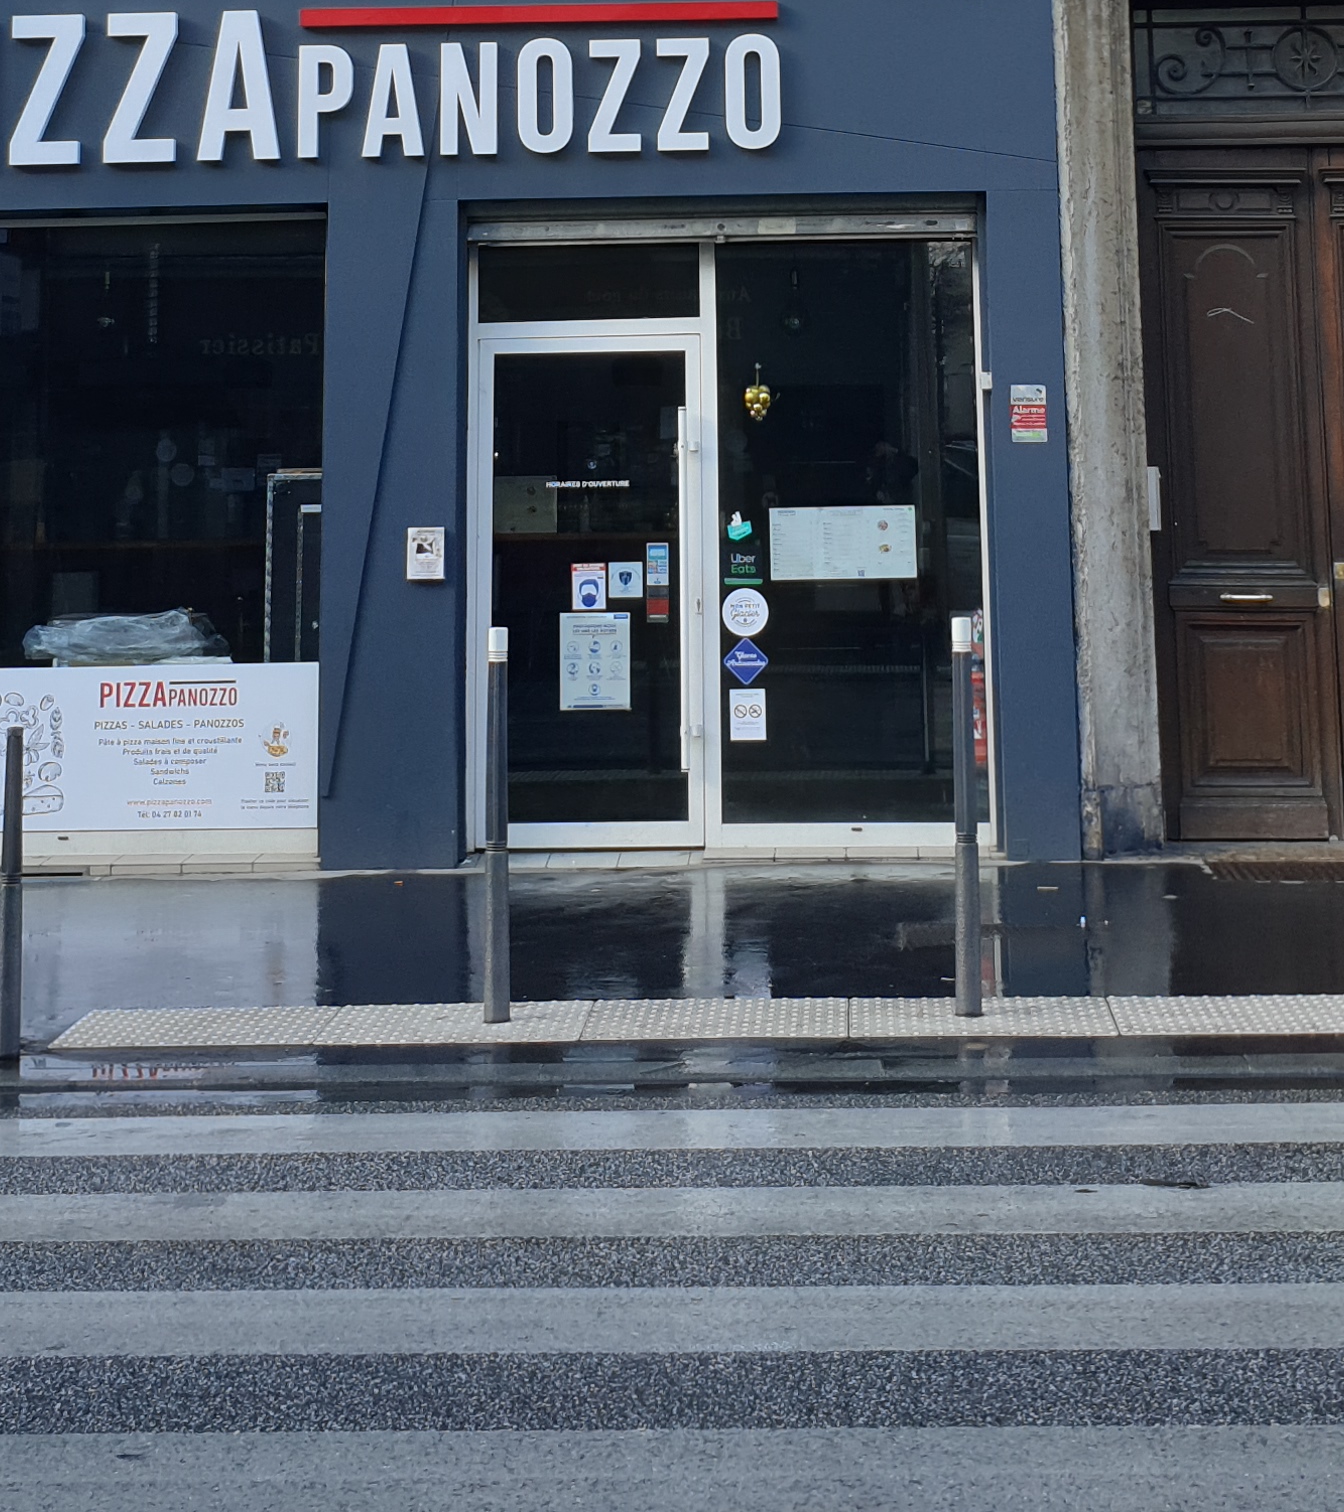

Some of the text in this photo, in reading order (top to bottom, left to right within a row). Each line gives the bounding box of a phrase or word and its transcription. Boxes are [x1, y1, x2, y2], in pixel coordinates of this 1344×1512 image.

[297, 33, 783, 160] PANOZZO
[730, 553, 756, 563] Uber
[730, 564, 756, 574] Eats
[99, 681, 238, 708] PIZZA PANOZZO
[94, 721, 128, 730] PIZZAS
[138, 720, 183, 729] SALADES
[193, 718, 245, 728] PANOZZOS
